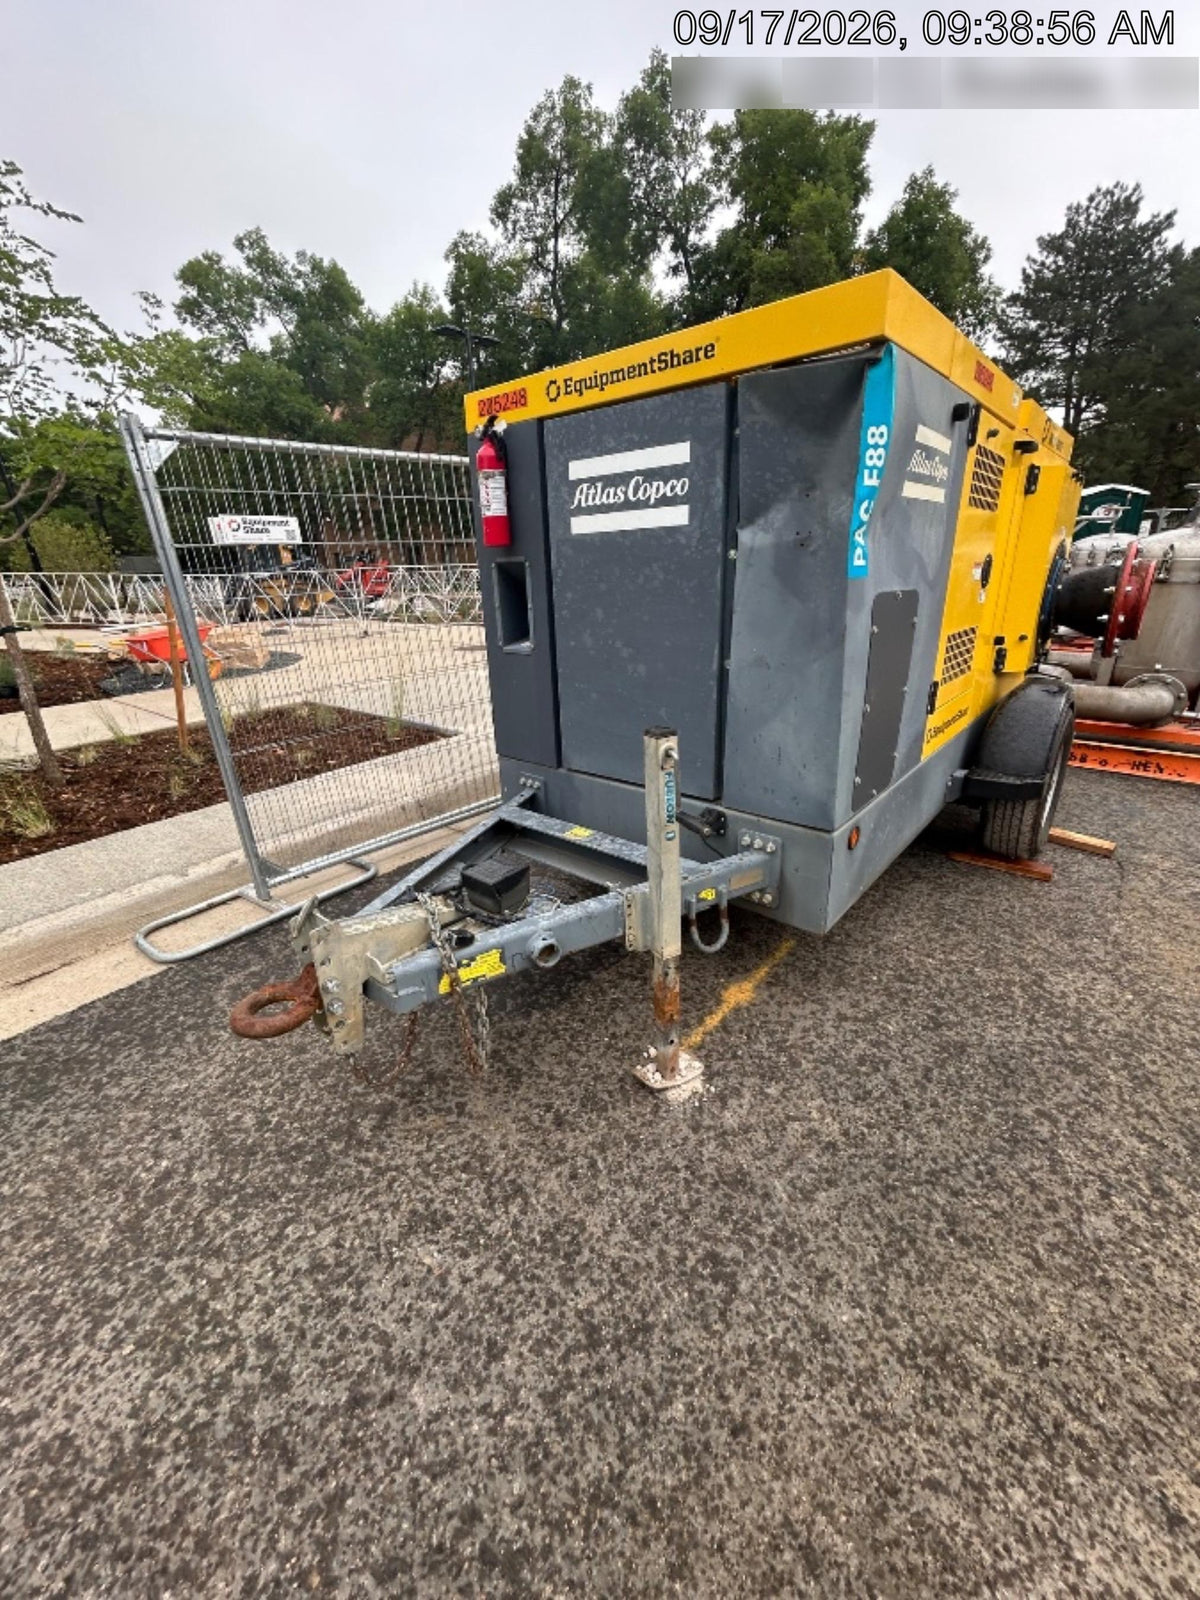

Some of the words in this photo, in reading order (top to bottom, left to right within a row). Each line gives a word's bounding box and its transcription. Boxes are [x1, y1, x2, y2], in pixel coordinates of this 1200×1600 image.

[563, 341, 716, 396] EquipmentShare
[863, 424, 888, 487] F88
[570, 480, 625, 509] Atlas
[627, 475, 689, 505] Copco
